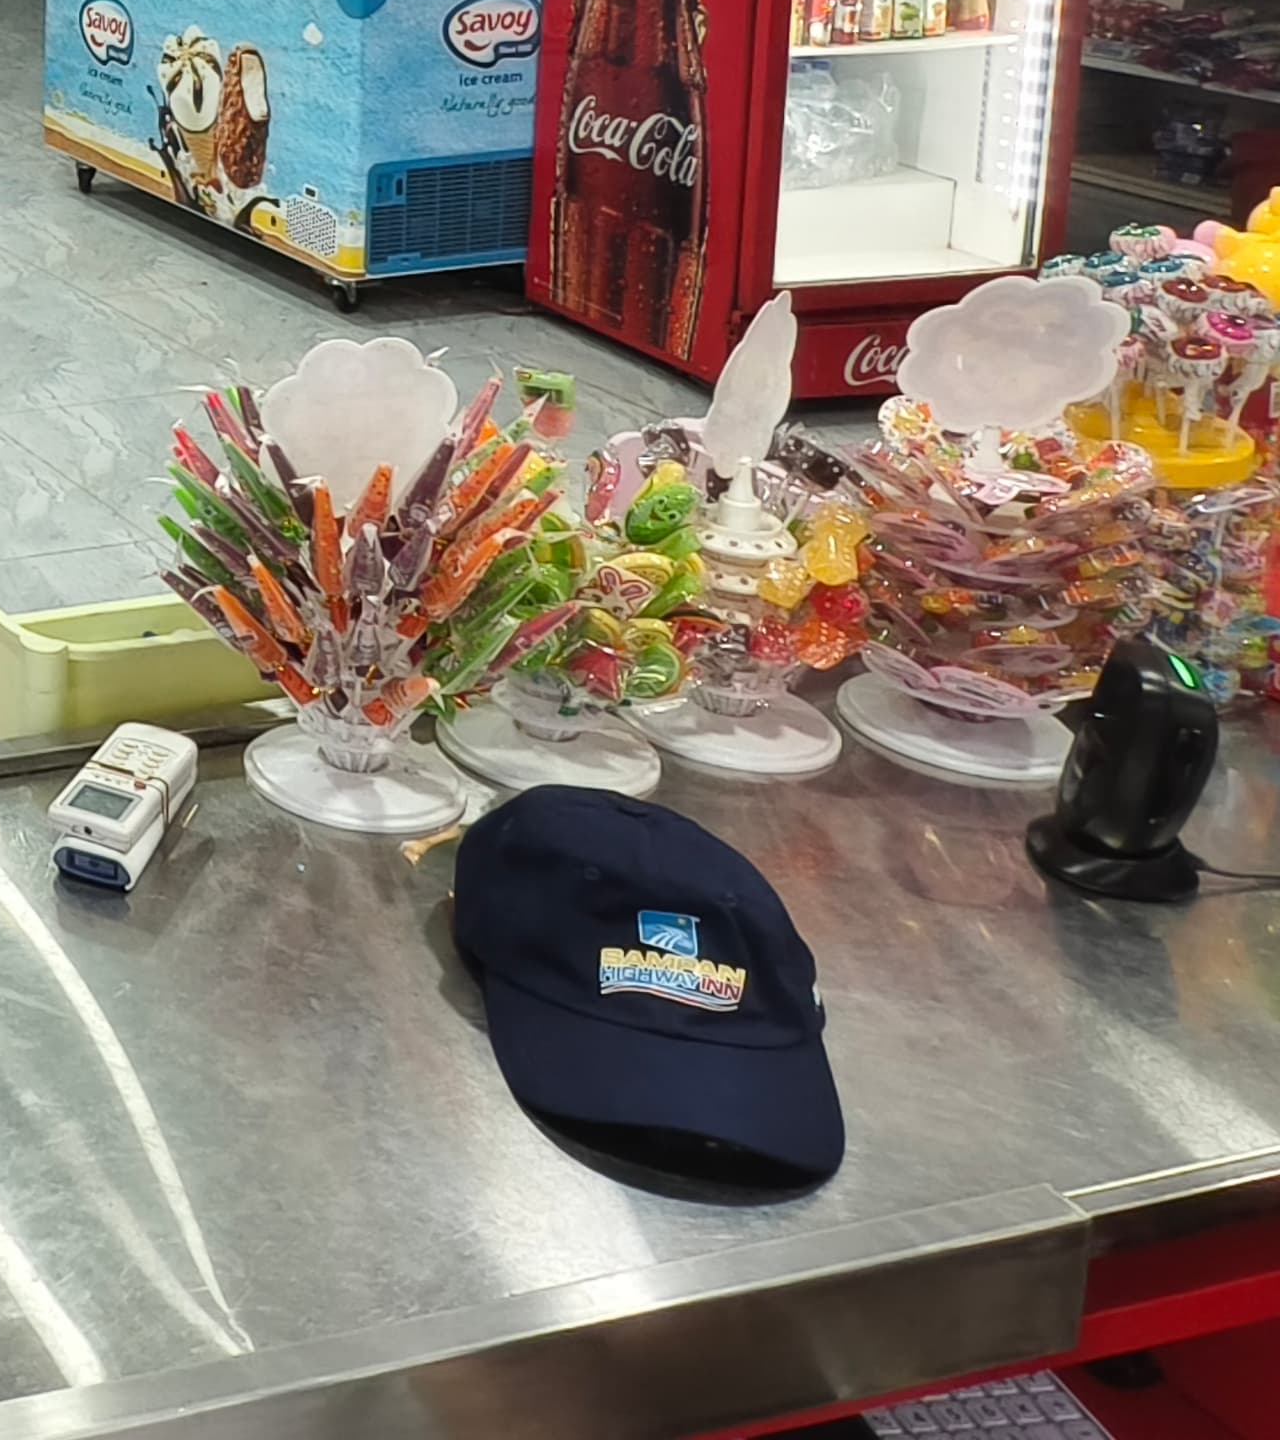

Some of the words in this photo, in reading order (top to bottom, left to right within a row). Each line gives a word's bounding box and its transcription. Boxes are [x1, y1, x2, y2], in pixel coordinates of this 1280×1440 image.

[85, 6, 128, 44] Savoy
[455, 8, 533, 36] Savoy
[481, 73, 523, 85] cream
[568, 95, 698, 188] Coca-Cola
[600, 965, 700, 990] HIGHWAY
[699, 976, 744, 1002] INN
[601, 948, 746, 985] SAMPAN
